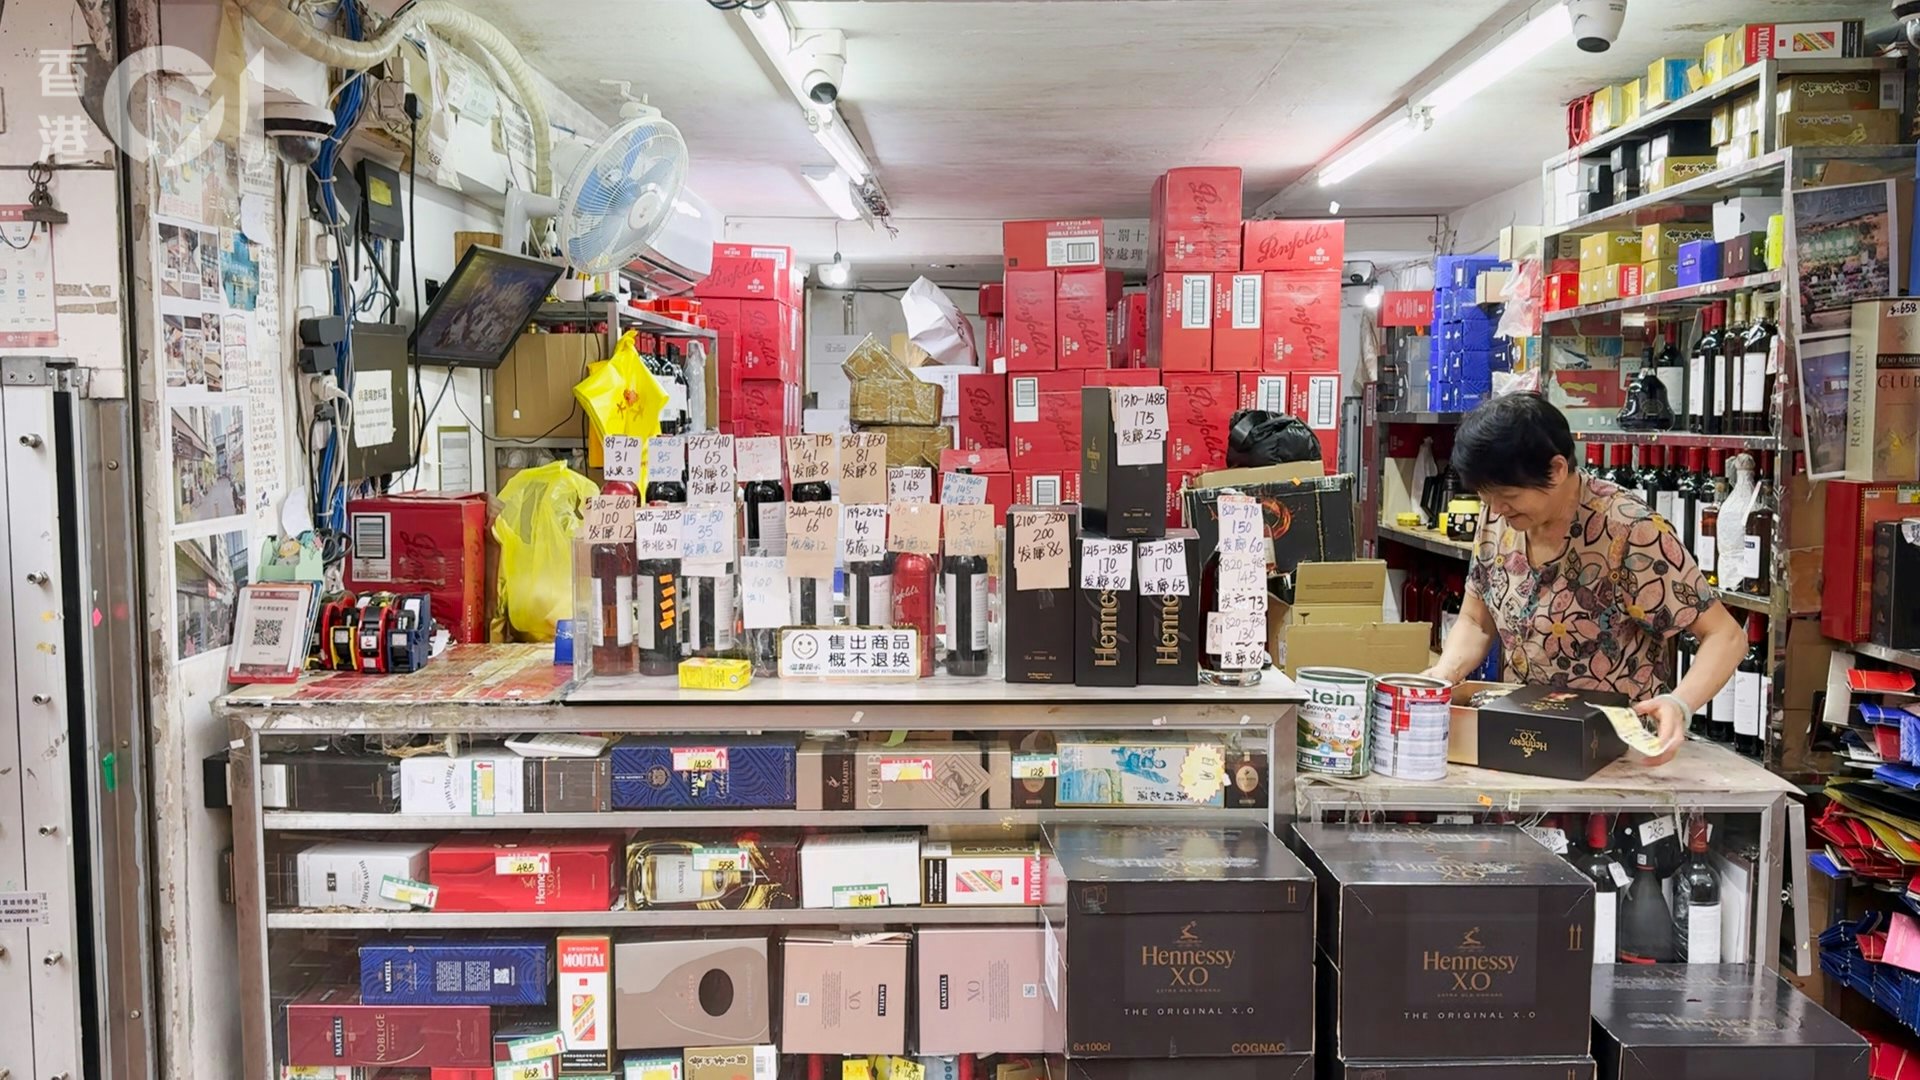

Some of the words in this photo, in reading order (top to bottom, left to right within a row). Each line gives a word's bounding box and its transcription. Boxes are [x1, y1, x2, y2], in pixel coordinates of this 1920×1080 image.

[1257, 226, 1332, 263] Penfolds
[1134, 410, 1155, 425] 175
[1145, 429, 1162, 441] 25
[605, 437, 638, 450] 89-120
[789, 434, 833, 451] 134-175
[614, 451, 628, 462] 31
[704, 450, 721, 464] 65
[803, 449, 817, 462] 41
[856, 448, 869, 463] 81
[627, 466, 634, 475] 3
[720, 465, 728, 478] 8
[820, 461, 829, 475] 8
[869, 461, 877, 476] 8
[720, 482, 731, 493] 12
[903, 480, 919, 492] 145
[601, 511, 619, 525] 100
[683, 510, 724, 525] 115-150
[789, 505, 833, 519] 344-410
[1222, 504, 1259, 519] 820-970
[806, 518, 819, 532] 66
[855, 520, 869, 534] 46
[1014, 512, 1067, 528] 2100-2300
[1232, 520, 1252, 534] 150
[619, 525, 633, 539] 12
[652, 523, 668, 536] 140
[697, 524, 713, 539] 35
[1033, 528, 1055, 543] 200
[666, 539, 678, 551] 37
[871, 544, 882, 554] 12
[1046, 540, 1063, 558] 86
[1083, 544, 1128, 558] 1215-1385
[1138, 542, 1184, 558] 1215-1385
[1248, 537, 1263, 553] 60
[1155, 557, 1173, 572] 170
[1112, 575, 1127, 589] 80
[1171, 578, 1186, 592] 65
[1095, 590, 1117, 666] Hennes
[1156, 593, 1179, 665] Henne
[1238, 627, 1255, 641] 130
[828, 634, 910, 650] 售出商品
[828, 652, 910, 668] 概不退换
[1249, 650, 1262, 665] 86
[1030, 767, 1044, 777] 128
[516, 862, 535, 873] 485
[718, 860, 735, 871] 558
[328, 874, 336, 890] 15
[562, 953, 605, 967] MOUTAI
[1142, 946, 1235, 969] Hennessy
[1423, 951, 1519, 974] Hennessy
[1171, 967, 1209, 986] X.O
[1452, 971, 1491, 990] X.O
[968, 980, 981, 1002] XO
[1124, 1008, 1148, 1016] THE
[1157, 1007, 1223, 1016] ORIGINAL
[1232, 1006, 1255, 1015] X.O
[1513, 1011, 1536, 1019] X.O
[376, 1013, 388, 1062] NOBLIGE
[1073, 1042, 1111, 1052] 6x100cl
[1232, 1043, 1286, 1053] COGNAC
[524, 1066, 539, 1078] 658
